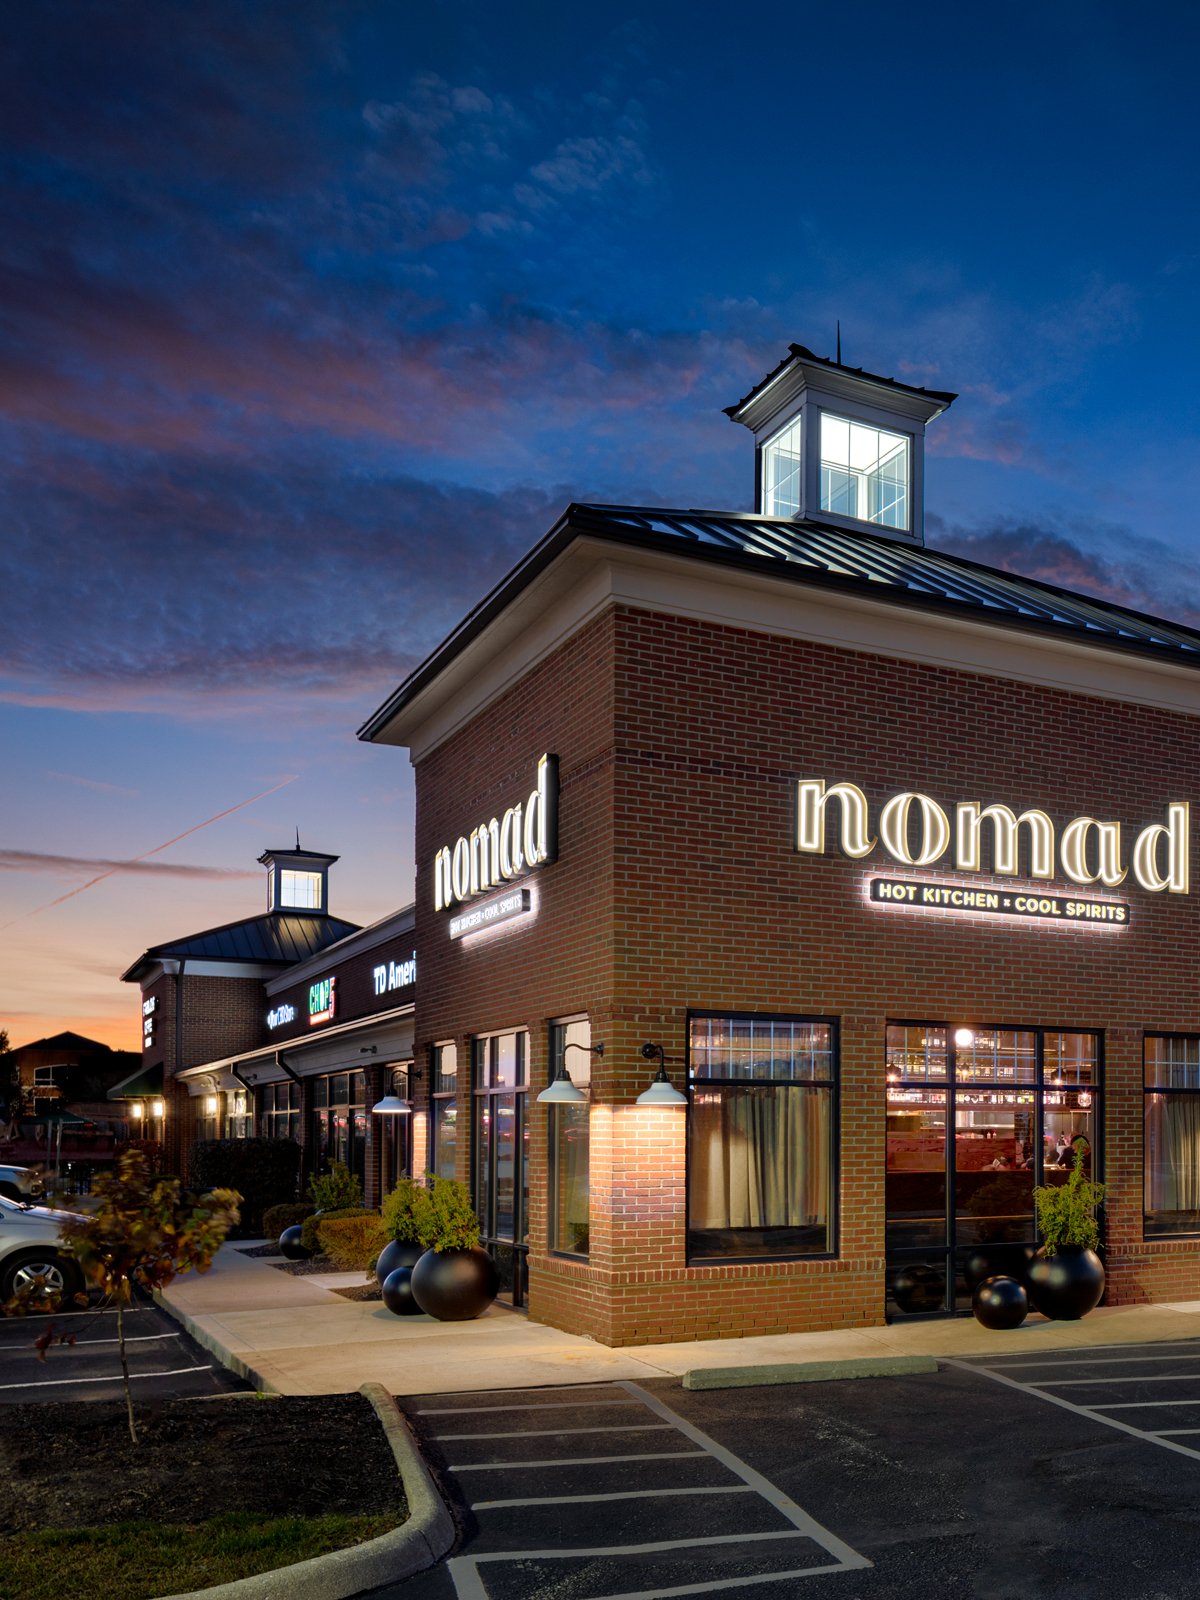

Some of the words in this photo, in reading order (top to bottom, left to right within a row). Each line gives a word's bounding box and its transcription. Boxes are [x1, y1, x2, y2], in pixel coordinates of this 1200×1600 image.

[435, 753, 553, 912] nomad
[796, 779, 1190, 895] nomad
[879, 883, 917, 900] HOT
[923, 888, 998, 908] KITCHEN
[1015, 897, 1061, 915] COOL
[1066, 902, 1125, 921] SPIRITS
[373, 965, 387, 995] TD
